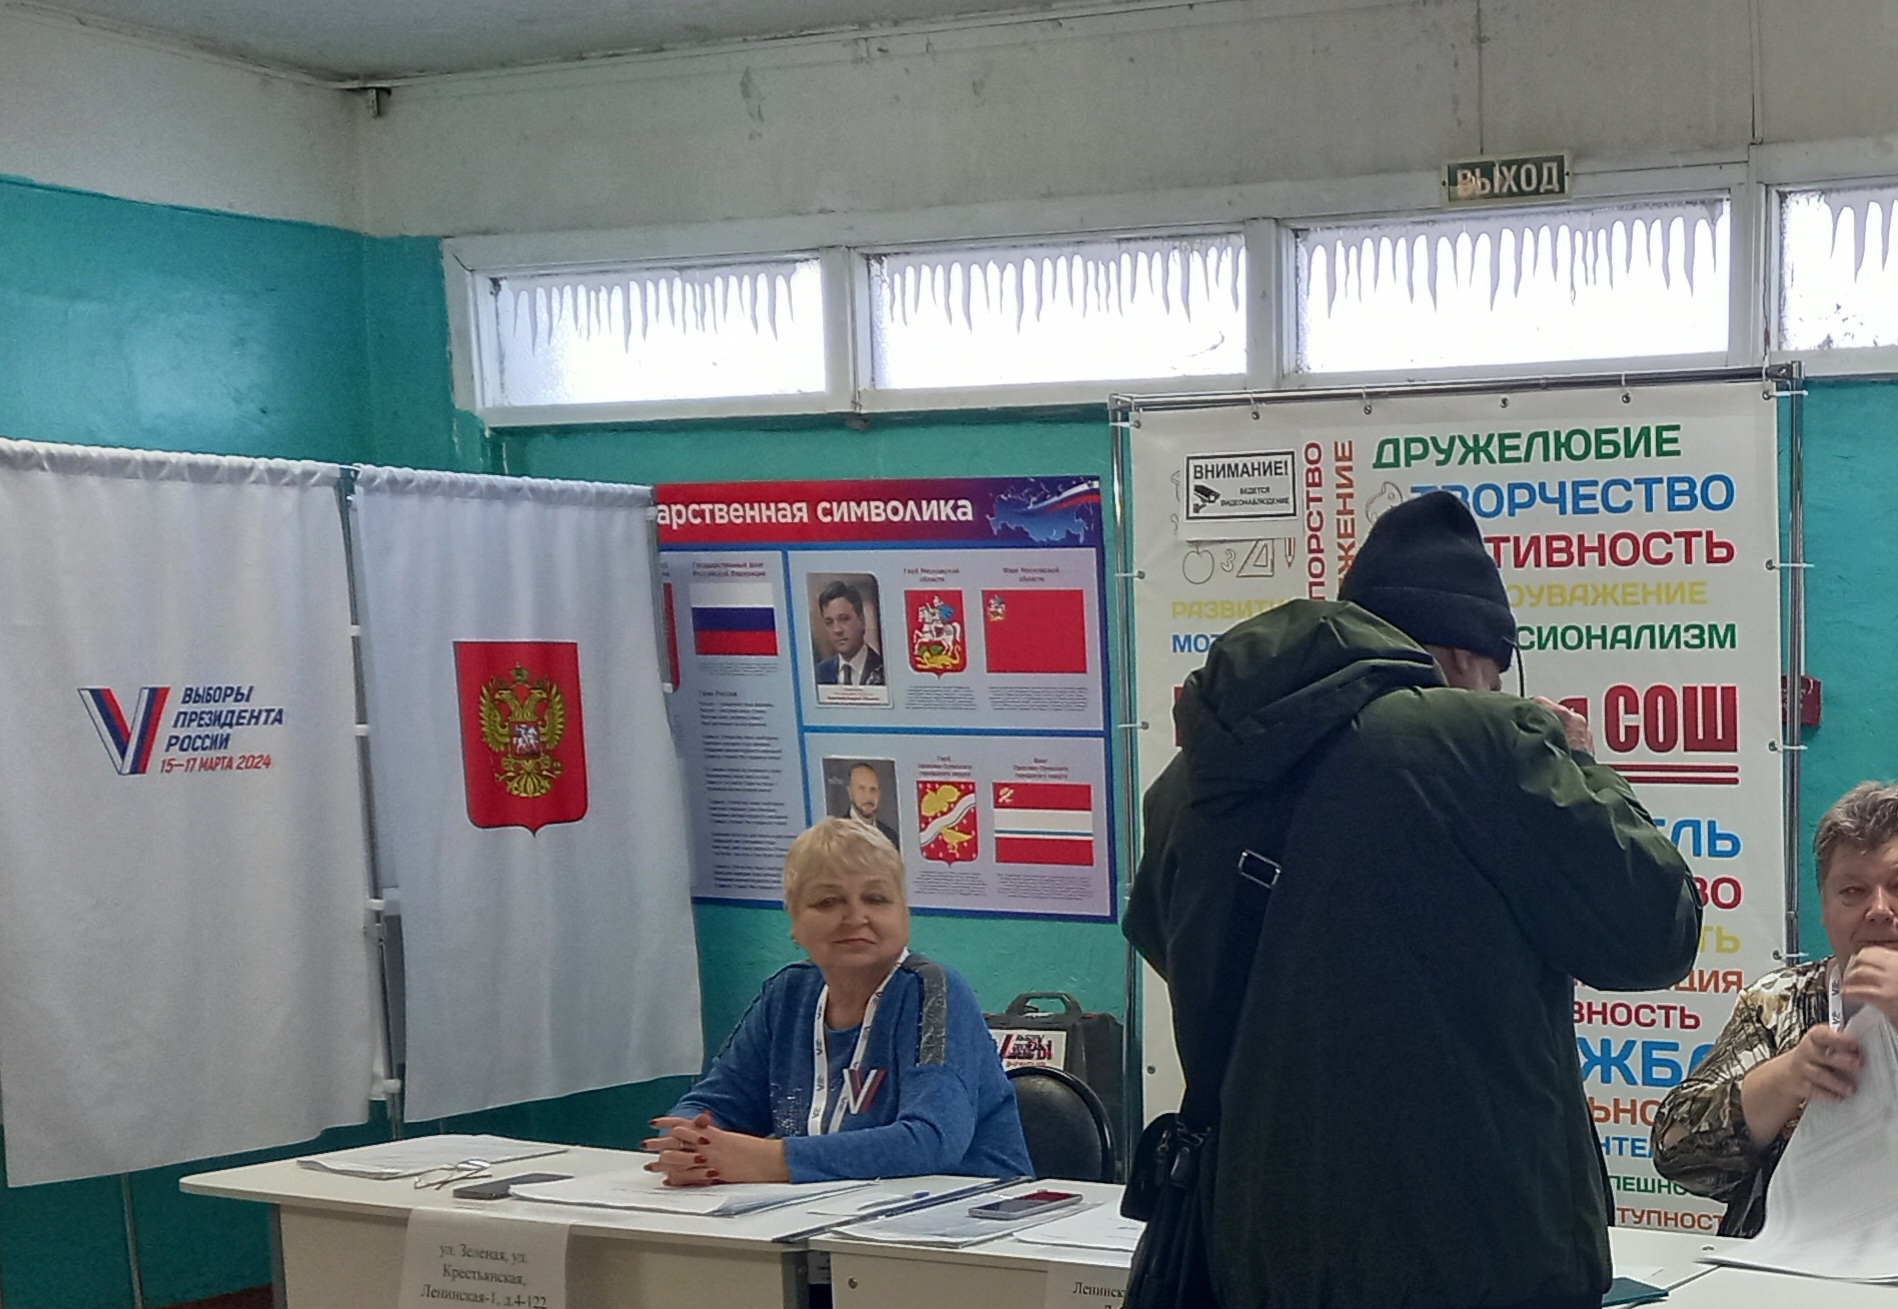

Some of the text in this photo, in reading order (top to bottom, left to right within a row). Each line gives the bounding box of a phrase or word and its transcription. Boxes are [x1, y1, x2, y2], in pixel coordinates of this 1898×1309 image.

[1456, 161, 1560, 197] ВЫХОД
[1372, 424, 1681, 469] ДРУЖЕЛЮБИЕ
[1193, 460, 1289, 480] ВНИМАНИЕ!
[657, 499, 974, 530] арственная символика
[1304, 442, 1326, 600] ПОРСТВО
[1483, 530, 1735, 568] ТИВНОСТЬ
[1506, 580, 1709, 608] ОУВАЖЕНИЕ
[1516, 624, 1737, 651] СИОНАЛИЗМ
[181, 685, 254, 705] ВЫБОРЫ
[172, 708, 284, 729] ПРЕЗИДЕНТА
[1604, 684, 1738, 753] СОШ
[165, 733, 232, 752] РОССИИ
[199, 755, 233, 772] МАРТА
[235, 754, 272, 771] 2024
[1573, 1000, 1701, 1030] ВНОСТЬ
[439, 1243, 528, 1264] ул. Зеленая, ул.
[442, 1263, 526, 1287] Крестьянская,
[1072, 1281, 1126, 1299] Ленинск
